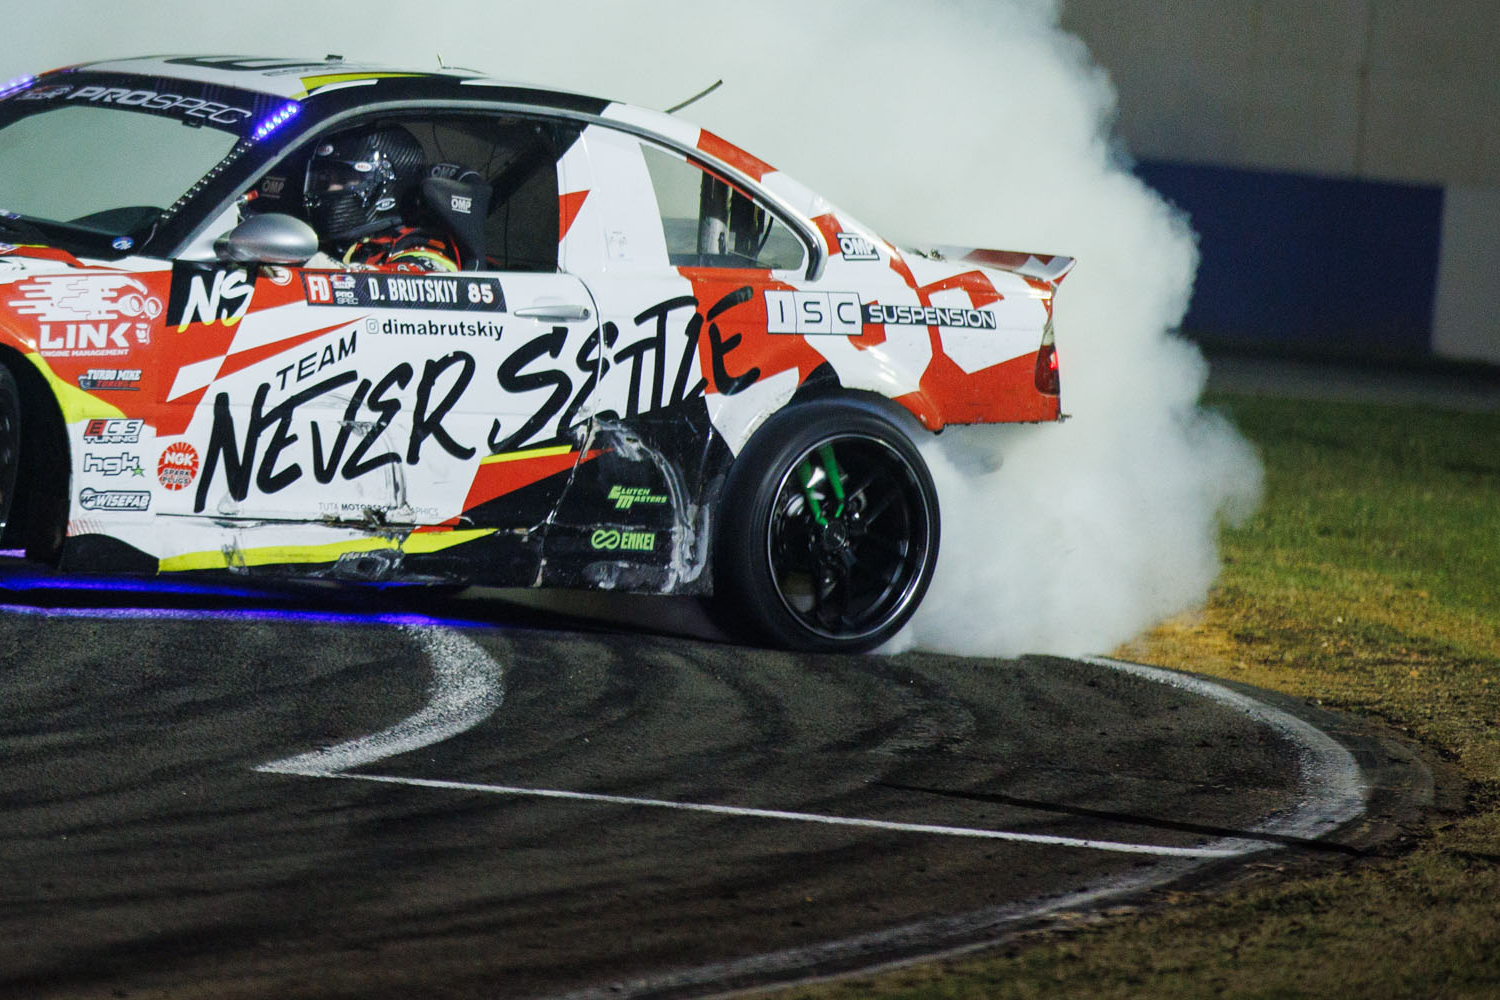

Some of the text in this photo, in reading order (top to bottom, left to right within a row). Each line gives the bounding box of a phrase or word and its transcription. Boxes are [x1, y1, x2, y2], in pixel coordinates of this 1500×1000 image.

[67, 85, 252, 125] PROSPEC
[451, 198, 472, 211] OMP
[840, 236, 875, 256] OMP
[308, 276, 331, 302] FD
[367, 277, 385, 301] D.
[387, 278, 458, 304] BRUTSKIY
[467, 282, 494, 304] 85
[177, 270, 255, 333] NS
[868, 304, 997, 329] SUSPENSION
[40, 322, 132, 349] LINK
[382, 318, 504, 342] dimabrutskiy
[72, 348, 130, 357] MANAGEMENT
[276, 330, 357, 391] TEAM
[116, 369, 142, 381] MIKE
[89, 420, 141, 435] ECS
[194, 350, 476, 513] NEVER
[84, 435, 138, 444] TUNING
[164, 451, 194, 467] NGK
[162, 476, 190, 485] PLUGS
[163, 468, 191, 477] SPARK
[96, 494, 150, 508] WISEFAB
[620, 531, 656, 551] ENKEI
